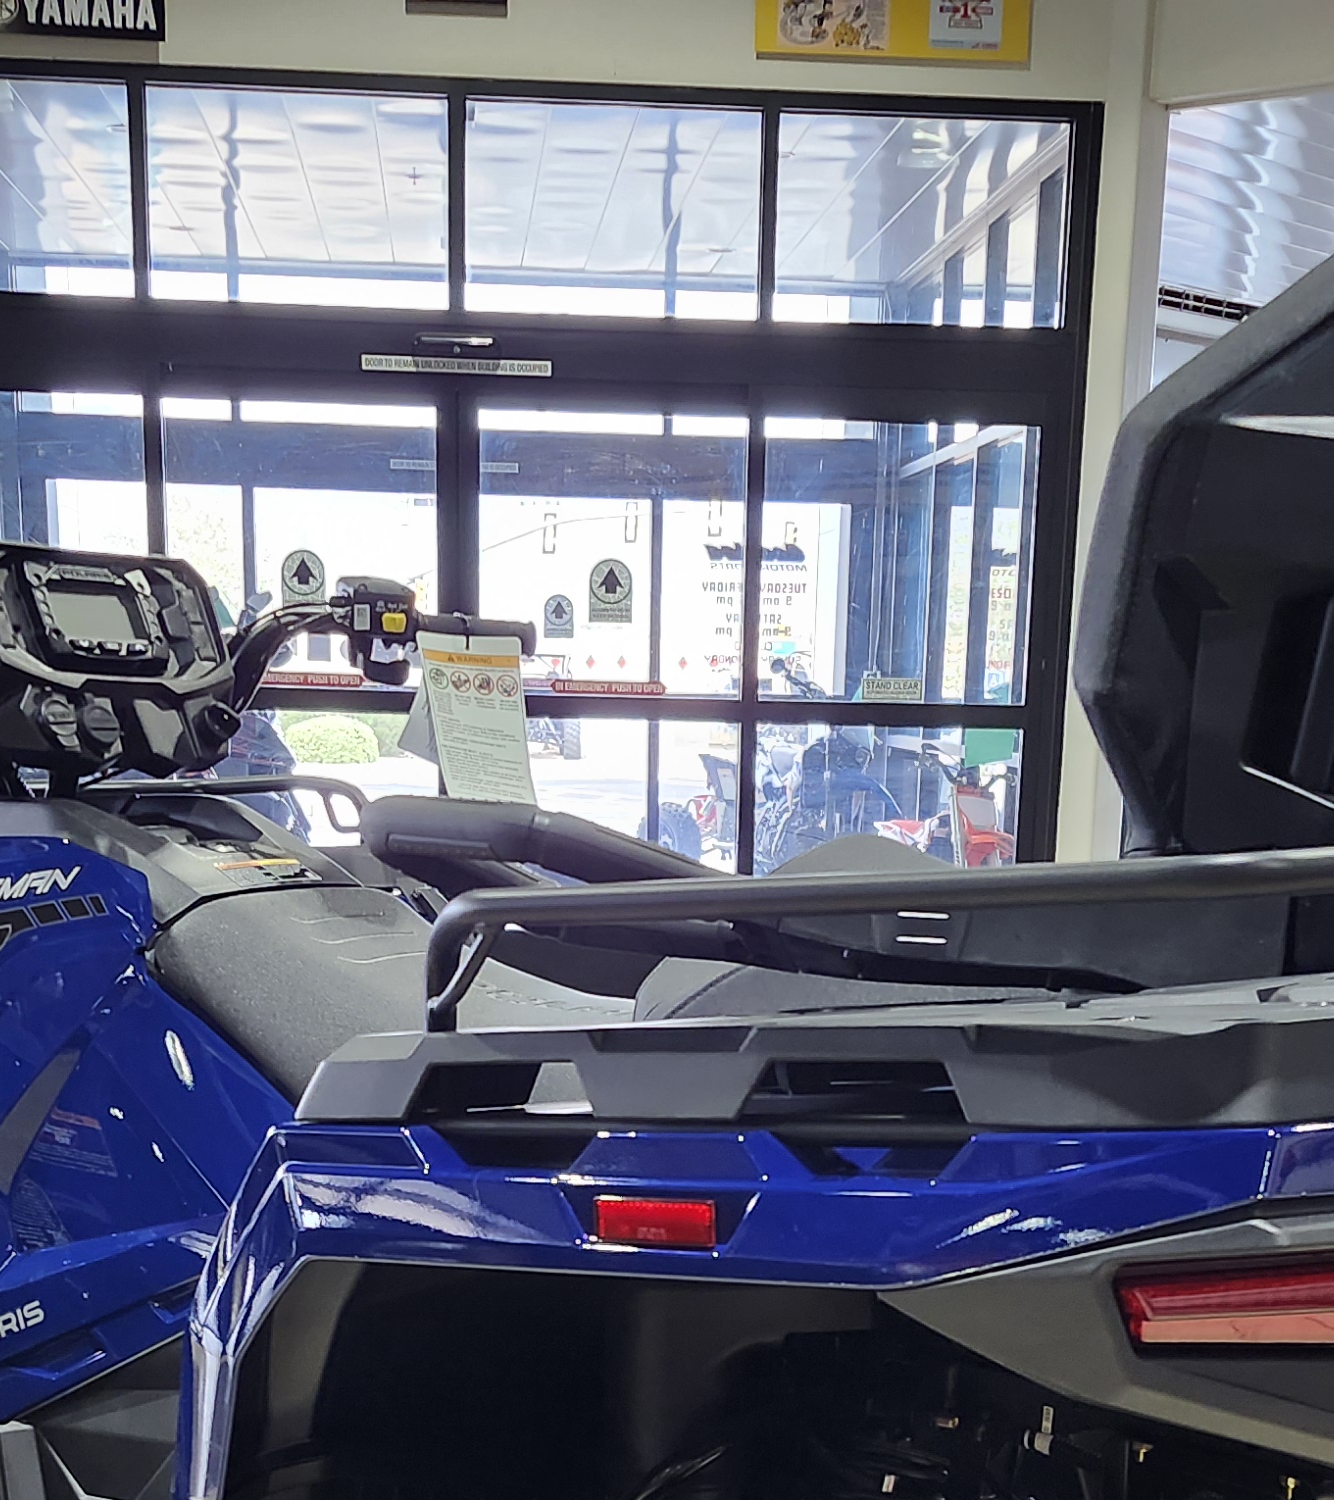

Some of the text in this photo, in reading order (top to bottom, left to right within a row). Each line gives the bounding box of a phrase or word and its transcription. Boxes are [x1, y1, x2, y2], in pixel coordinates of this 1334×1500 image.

[23, 0, 157, 31] YAMAHA
[364, 357, 384, 368] DOOR
[384, 358, 393, 368] TO
[394, 358, 420, 370] REMAIN
[420, 360, 455, 371] UNLOCKED
[457, 361, 476, 372] WHEN
[478, 362, 507, 373] BUILDING
[516, 363, 549, 374] OCCUPIED
[456, 656, 493, 665] WARNING
[307, 674, 328, 685] PUSH
[329, 675, 340, 685] TO
[340, 675, 361, 685] OPEN
[565, 681, 609, 692] EMERGENCY
[612, 682, 632, 692] PUSH
[632, 683, 642, 693] TO
[643, 683, 663, 693] OPEN
[866, 681, 919, 690] STAND CLEAR
